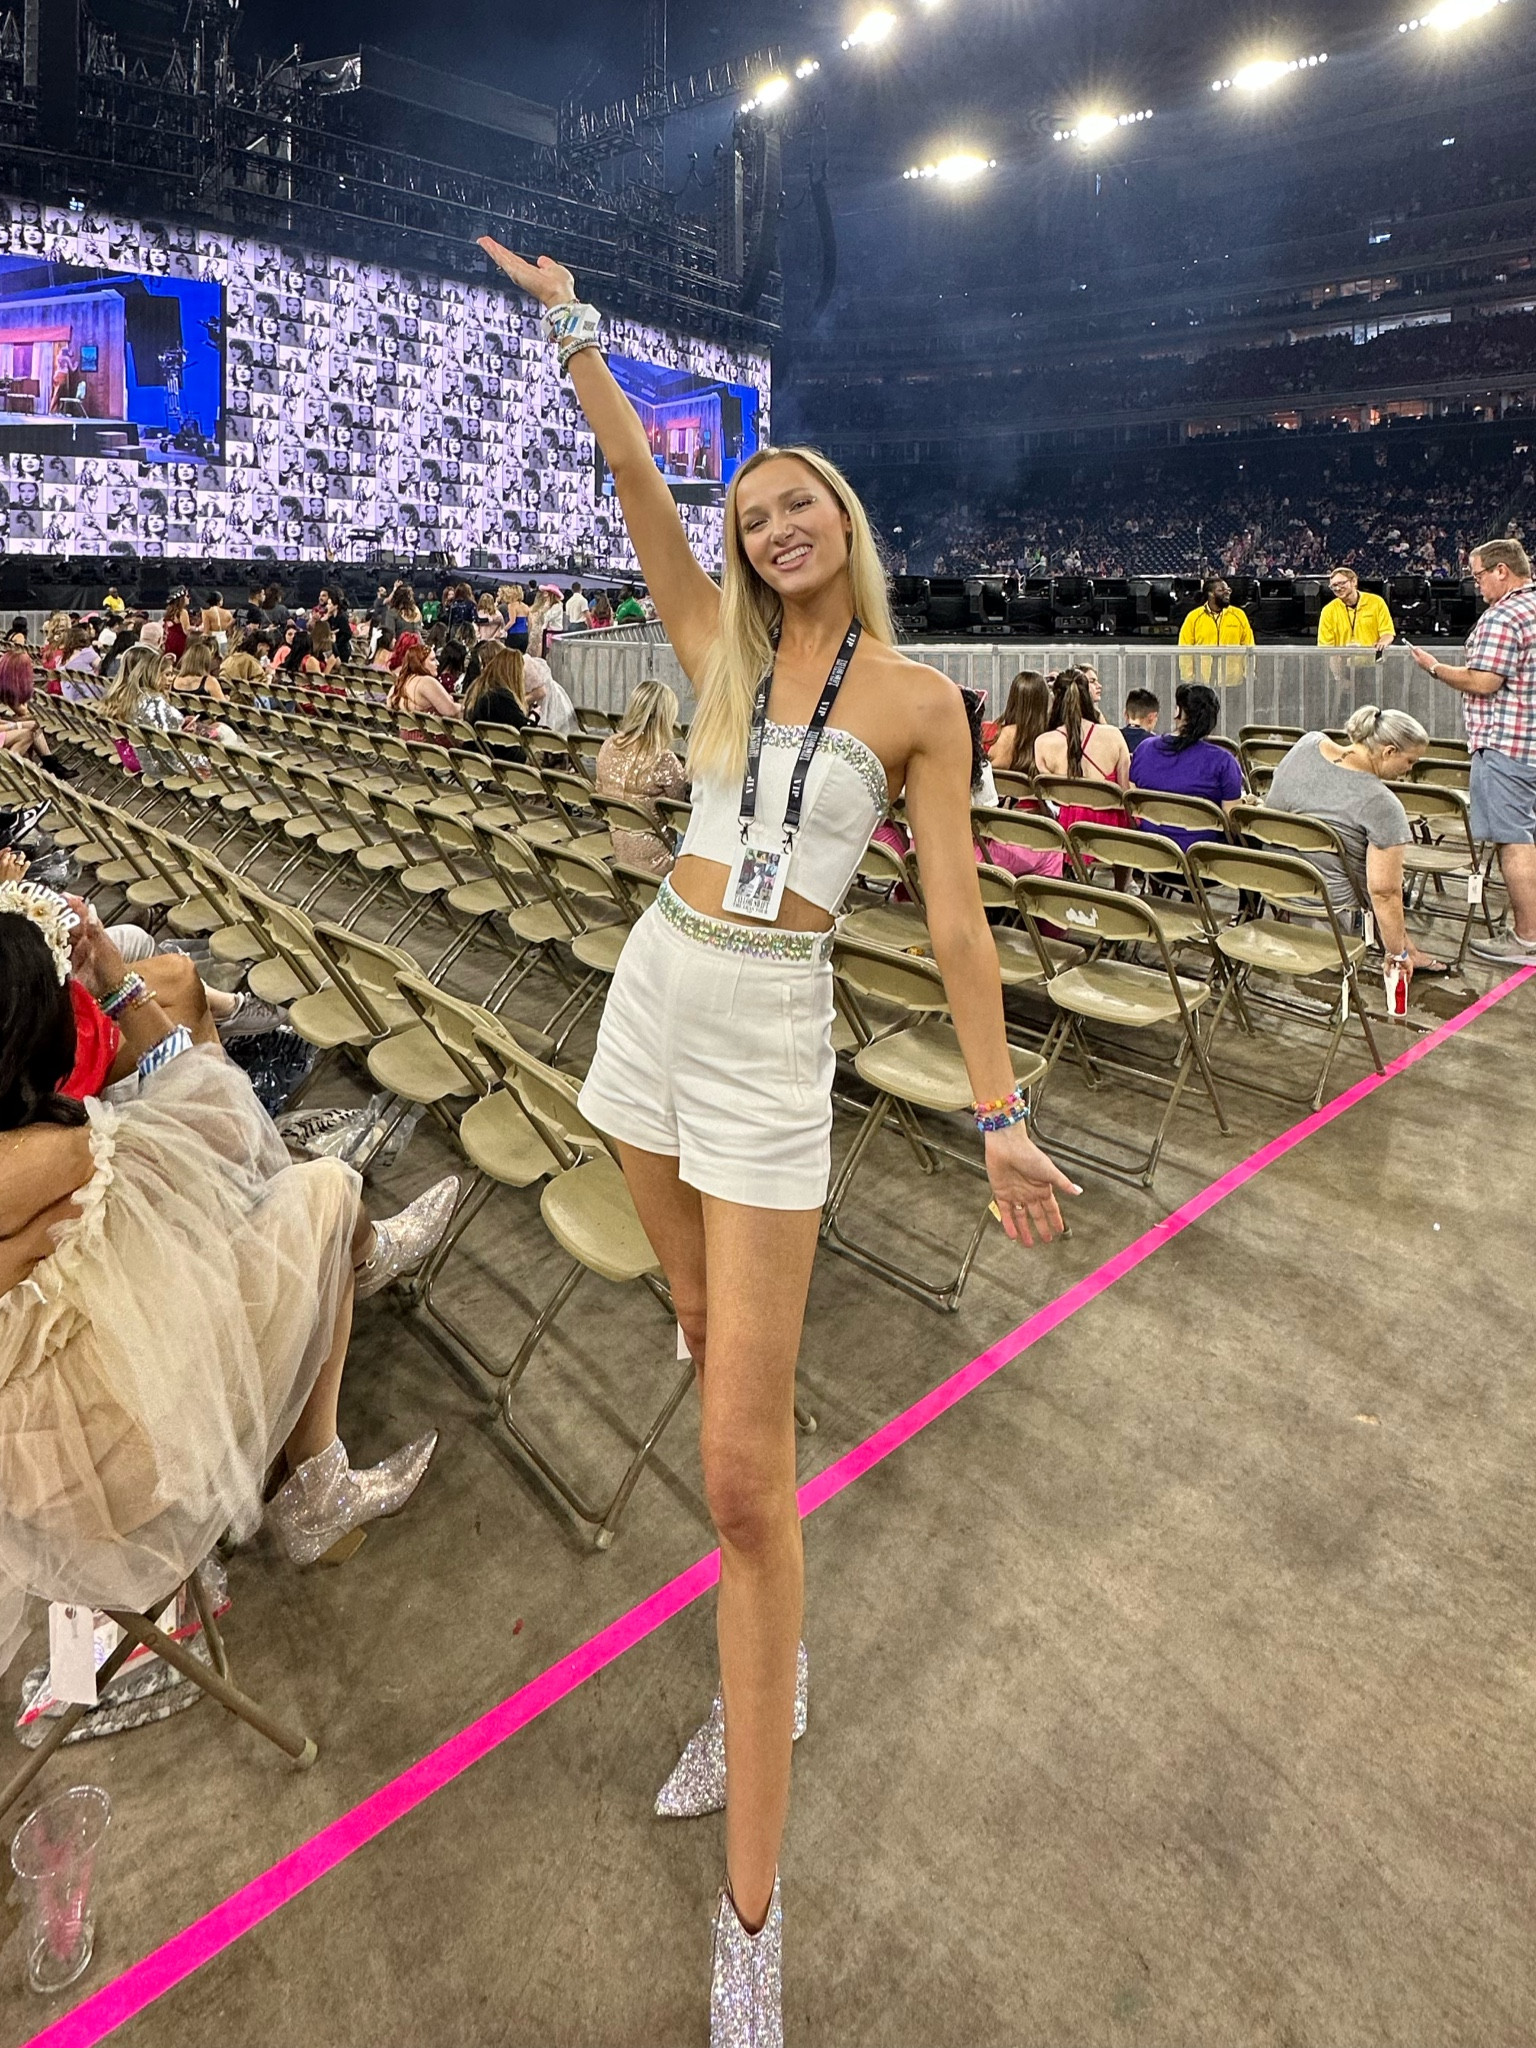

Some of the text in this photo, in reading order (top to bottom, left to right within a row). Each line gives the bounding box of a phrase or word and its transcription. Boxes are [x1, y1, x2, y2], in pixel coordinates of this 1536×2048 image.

[846, 632, 857, 648] VIP
[756, 693, 766, 708] VIP
[818, 701, 830, 717] VIP
[745, 775, 755, 794] VIP
[792, 779, 802, 798] VIP
